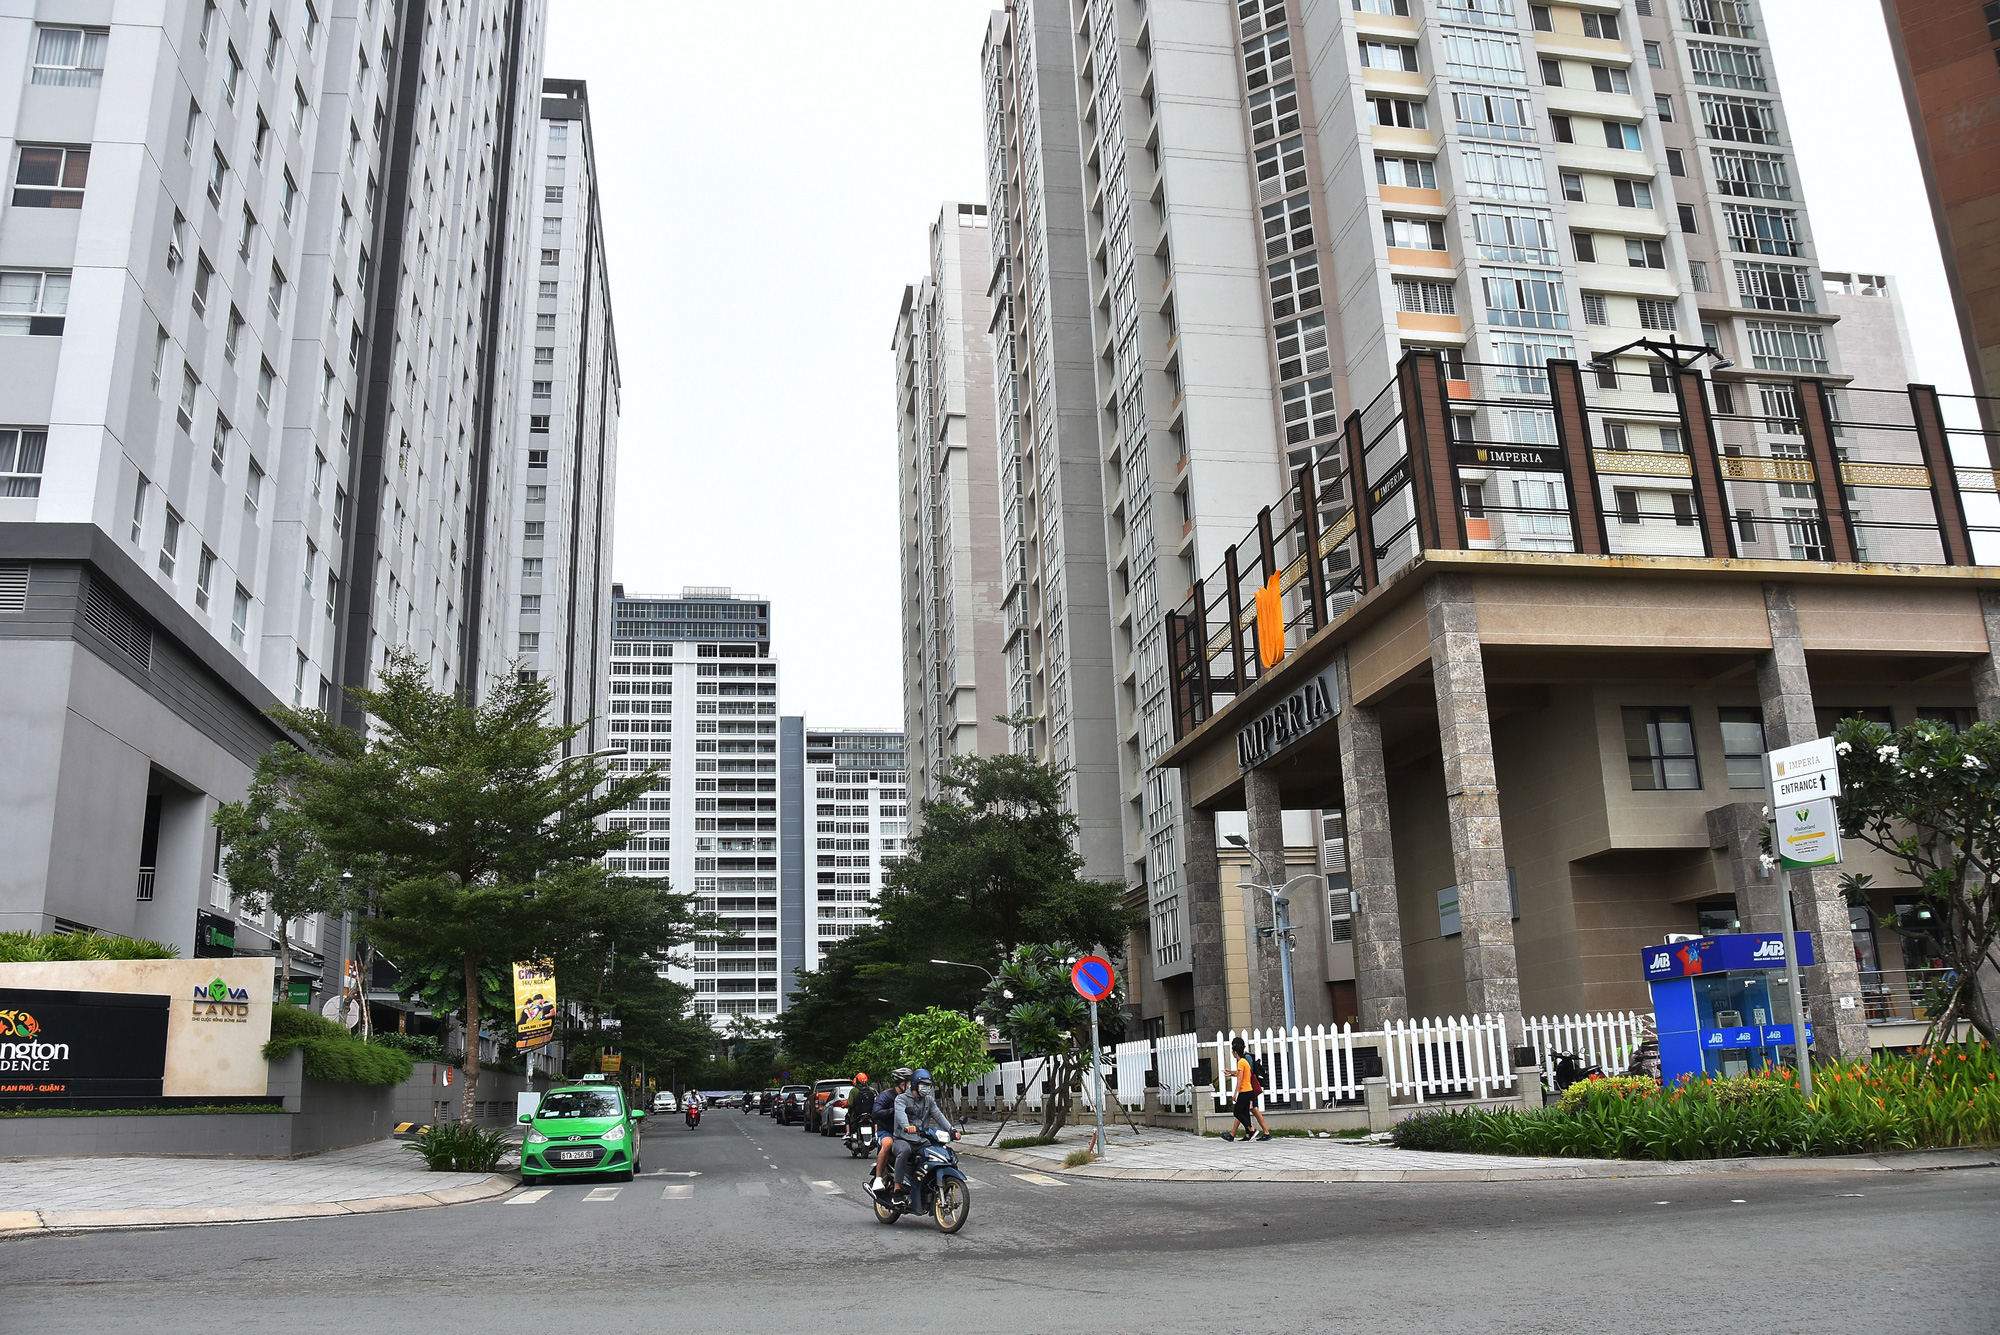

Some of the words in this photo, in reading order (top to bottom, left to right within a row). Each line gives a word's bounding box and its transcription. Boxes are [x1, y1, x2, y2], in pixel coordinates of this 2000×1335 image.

[1490, 451, 1543, 463] IMPERIA
[1380, 469, 1405, 498] IMPERIA
[1235, 676, 1333, 767] IMPERIA
[1788, 755, 1820, 770] IMPERIA
[1780, 778, 1818, 795] ENTRANCE
[1753, 940, 1785, 957] MB
[1650, 952, 1671, 969] MB
[194, 978, 249, 1001] NOVA
[192, 1003, 249, 1016] LAND
[1805, 1029, 1812, 1037] B
[0, 1039, 69, 1061] ngton
[0, 1060, 50, 1071] DENCE
[19, 1084, 34, 1092] PHÚ
[39, 1083, 60, 1093] QUẬN
